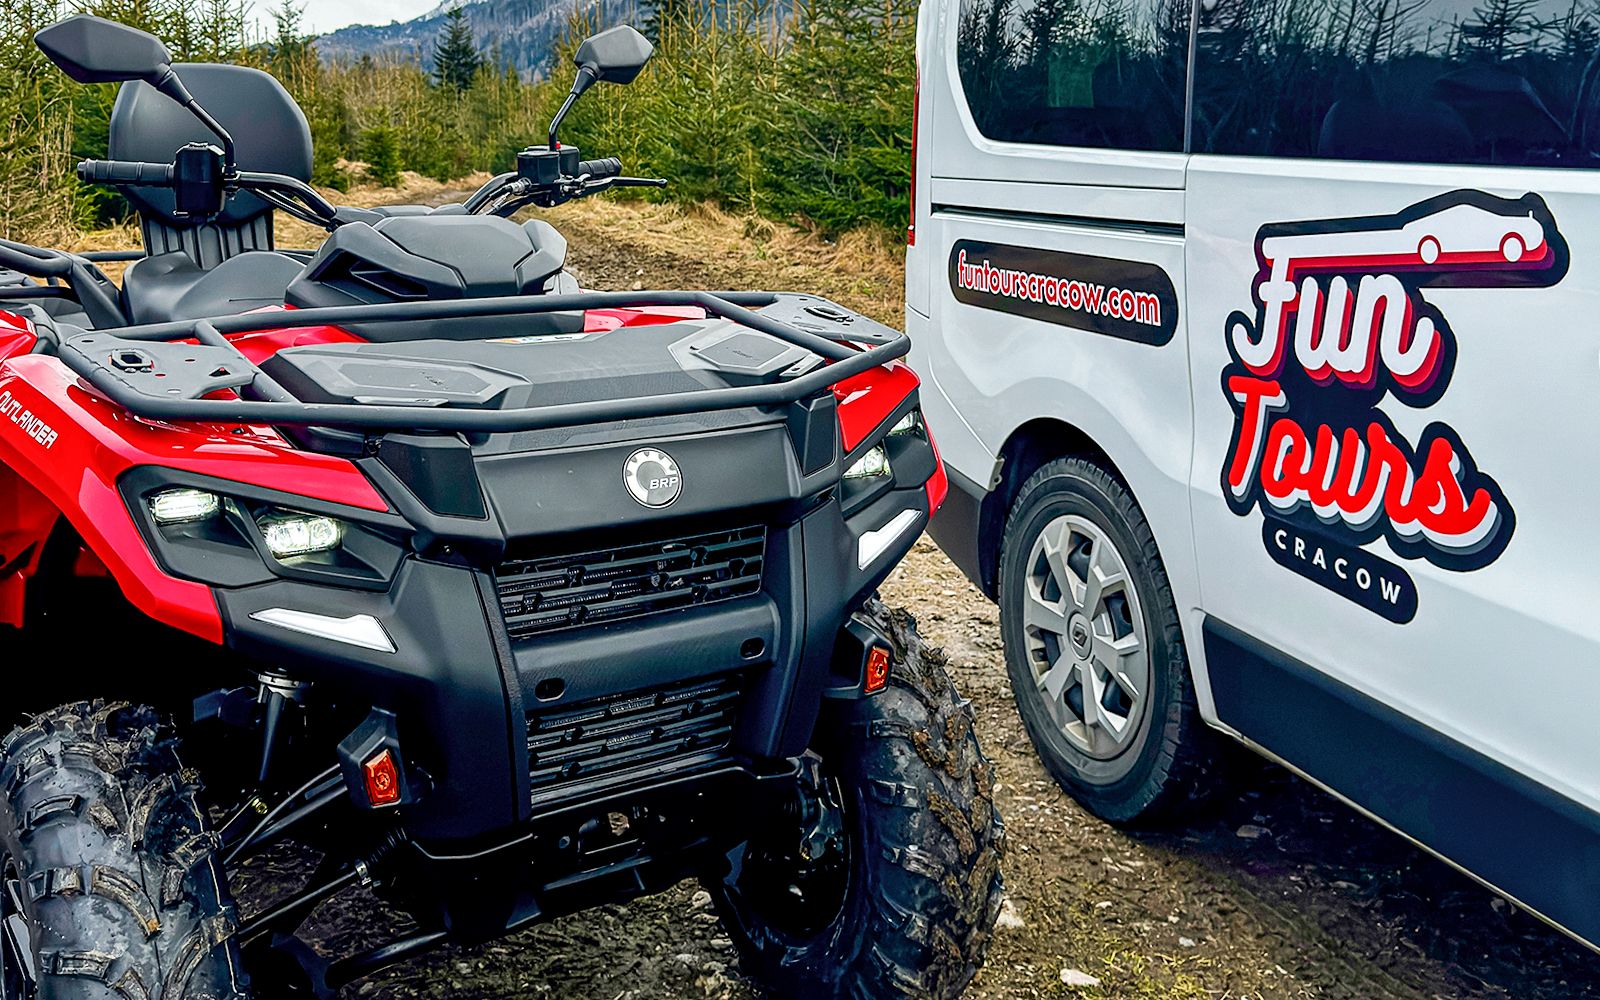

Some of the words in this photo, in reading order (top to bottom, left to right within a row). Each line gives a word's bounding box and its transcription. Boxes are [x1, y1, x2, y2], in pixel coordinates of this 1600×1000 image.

[958, 249, 1161, 326] funtourscracow.com
[649, 476, 679, 490] BRP
[1228, 375, 1496, 538] Tours
[1274, 529, 1401, 604] CRACOW
